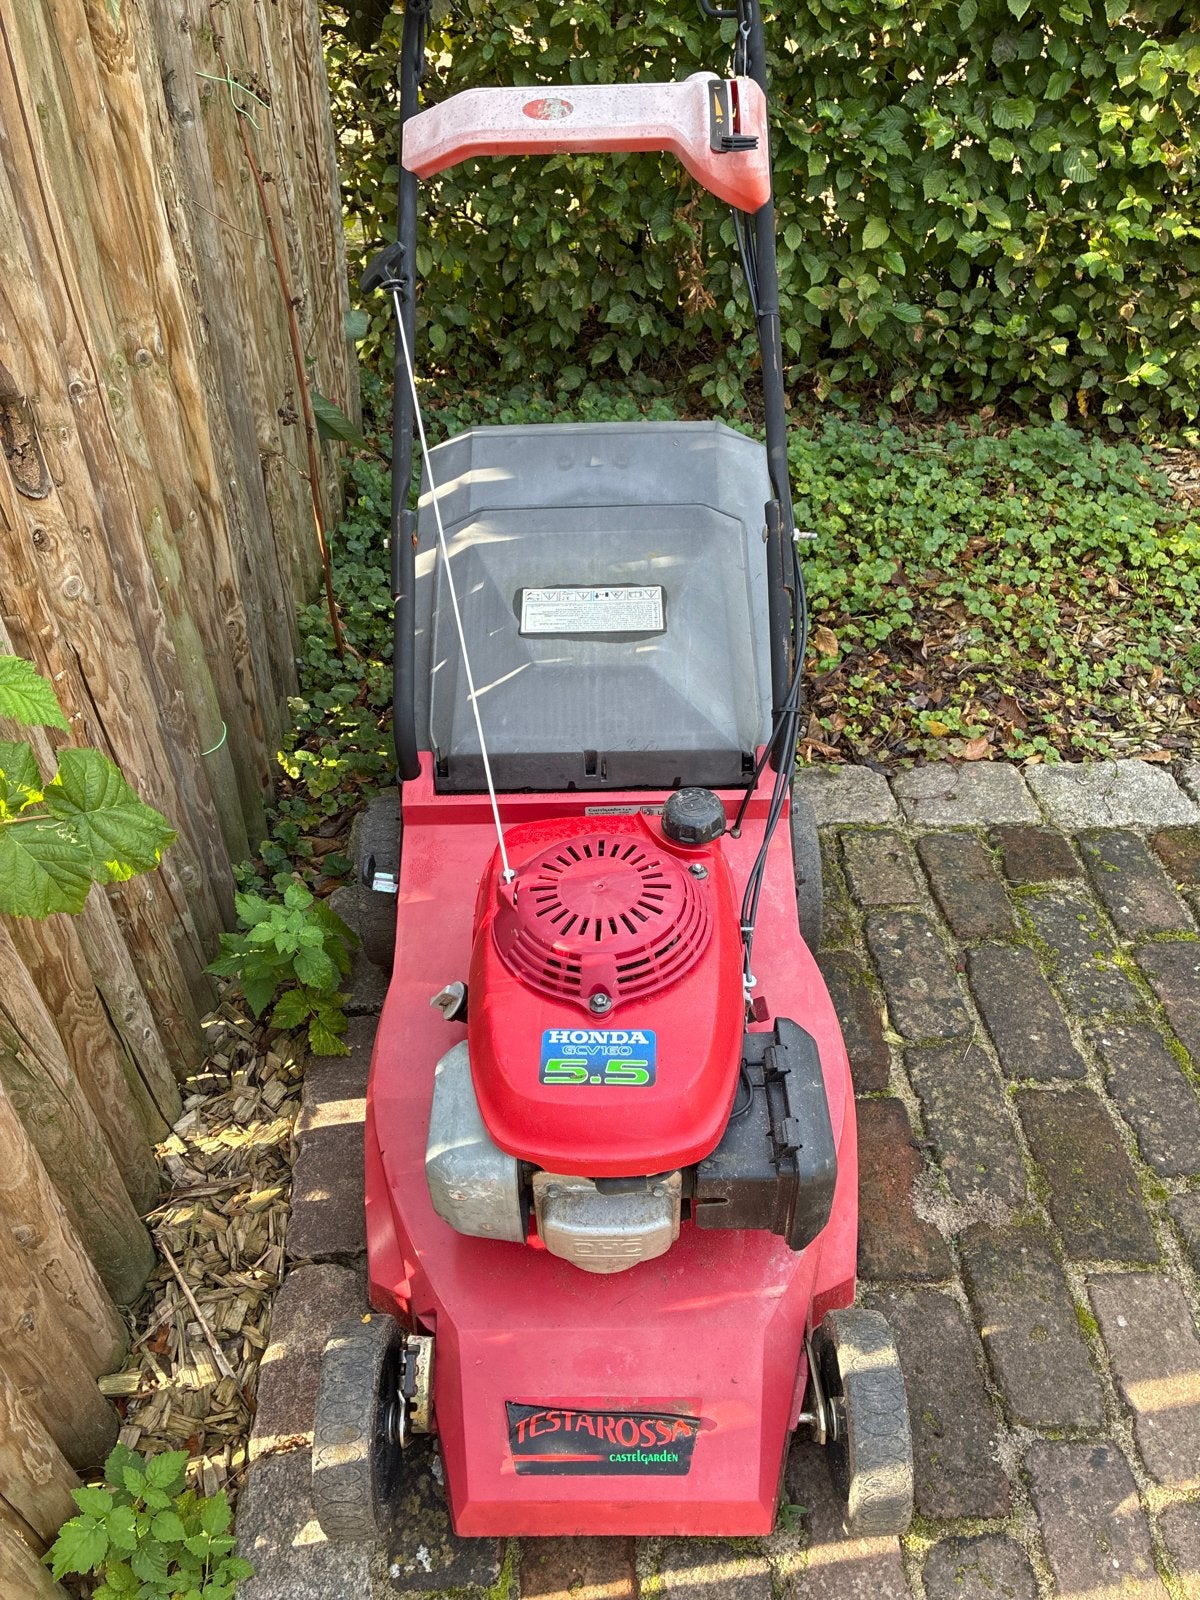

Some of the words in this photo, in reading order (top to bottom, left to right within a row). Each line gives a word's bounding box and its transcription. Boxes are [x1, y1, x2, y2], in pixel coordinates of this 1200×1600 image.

[548, 1030, 649, 1045] HONDA
[561, 1045, 633, 1056] GCV160
[543, 1058, 650, 1085] 5.5
[515, 1411, 691, 1447] TESTAROSSA
